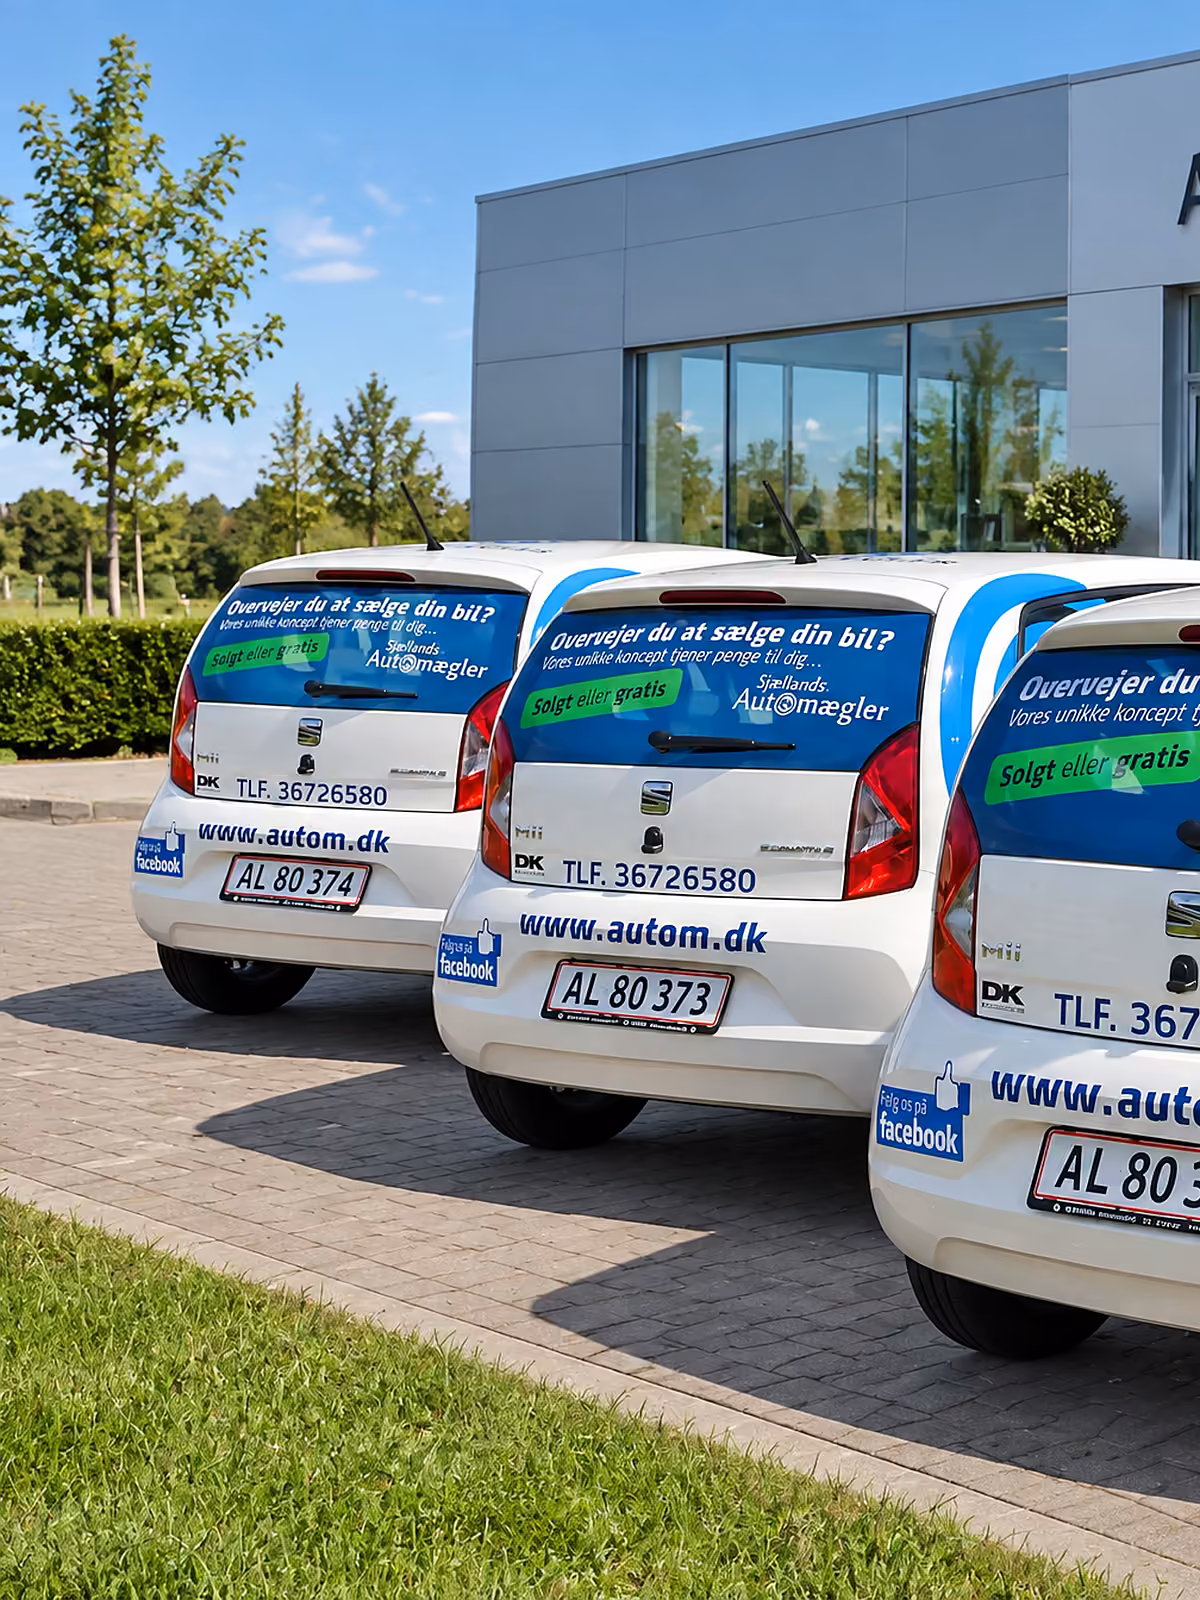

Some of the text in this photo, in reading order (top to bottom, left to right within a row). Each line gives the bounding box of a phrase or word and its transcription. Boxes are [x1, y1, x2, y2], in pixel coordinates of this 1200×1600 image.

[227, 596, 495, 623] Overvejer du at sælge din bil?
[550, 621, 895, 651] Overvejer du at sælge din bil?
[211, 639, 318, 667] Solgt eller gratis
[542, 647, 821, 670] Vores unikke koncept tjener penge til dig...
[532, 680, 666, 716] Solgt eller gratis
[1019, 669, 1155, 702] Overvejer
[1159, 668, 1200, 694] du
[1009, 708, 1052, 727] Vores
[1055, 704, 1110, 722] unikke
[1113, 703, 1187, 727] koncept
[1000, 743, 1190, 788] Solgt eller gratis
[197, 774, 220, 788] DK
[237, 778, 388, 806] TLF. 36726580
[199, 823, 391, 853] www.autom.dk
[137, 852, 180, 874] facebook
[515, 853, 545, 871] DK
[563, 860, 756, 893] TLF. 36726580
[236, 862, 355, 897] AL 80 374
[519, 913, 768, 953] www.autom.dk
[981, 941, 1021, 962] Mii
[440, 952, 494, 981] facebook
[561, 971, 711, 1016] AL 80 373
[982, 980, 1025, 1006] DK
[1054, 993, 1117, 1032] TLF.
[901, 1098, 912, 1112] os
[880, 1111, 958, 1154] facebook
[1055, 1145, 1108, 1194] AL
[1121, 1151, 1178, 1203] 80
